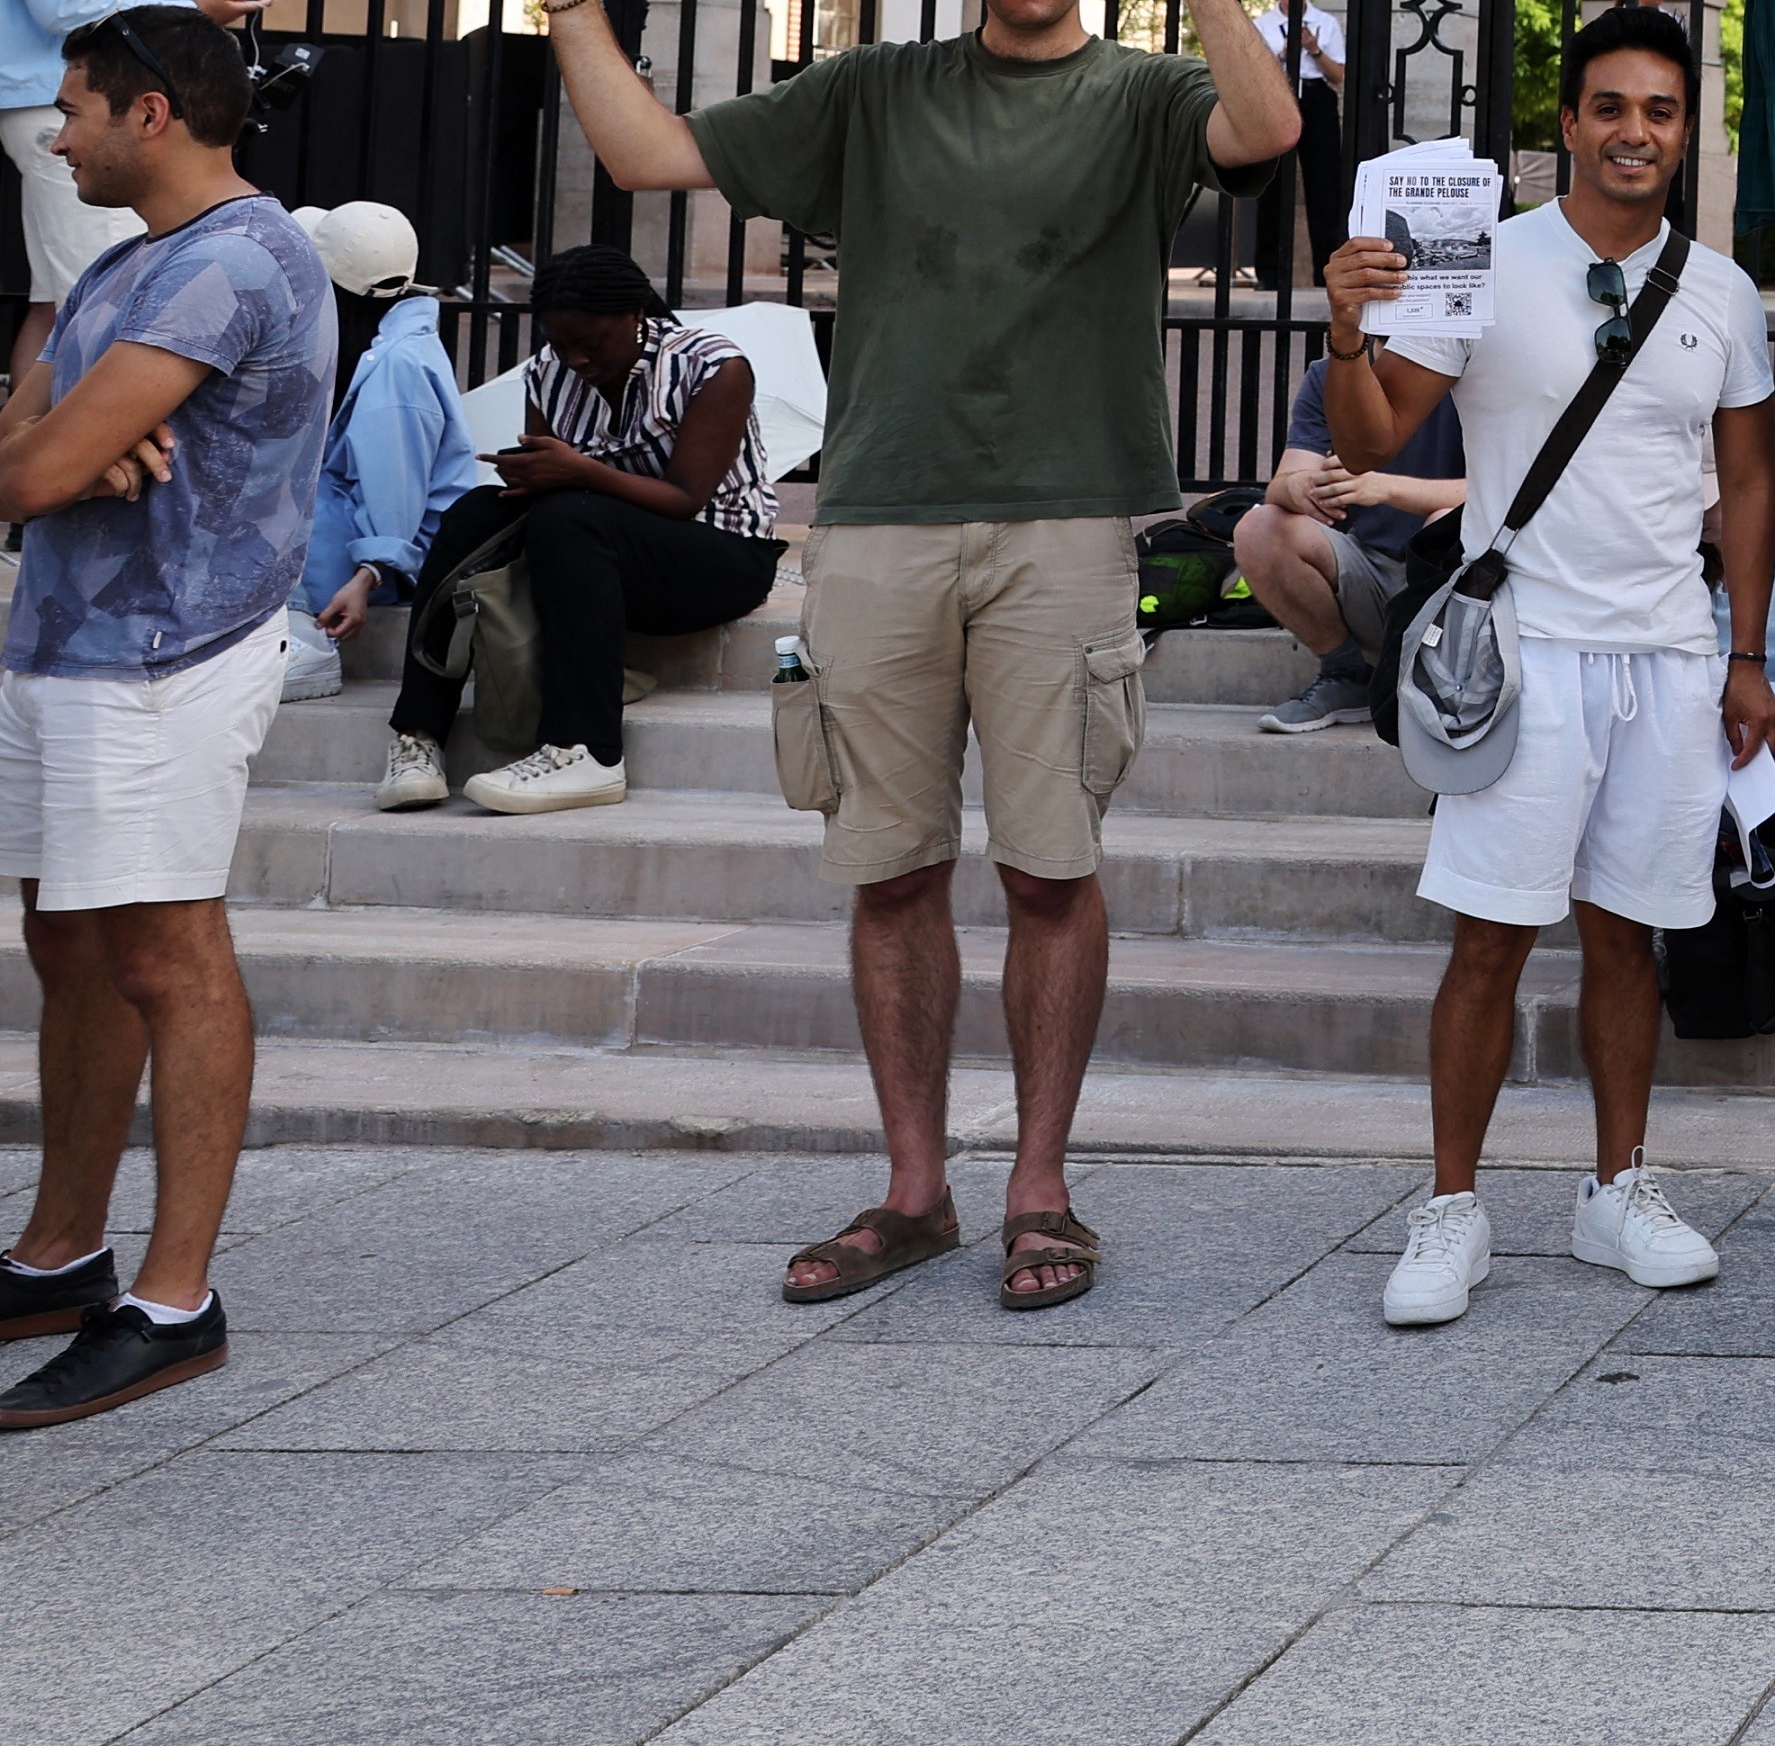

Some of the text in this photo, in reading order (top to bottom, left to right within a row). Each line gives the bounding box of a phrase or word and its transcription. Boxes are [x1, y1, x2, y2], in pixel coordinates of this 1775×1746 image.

[1389, 176, 1491, 187] SAY NO TO THE CLOSURE OF
[1389, 187, 1469, 198] THE GRANDE PELOUSE
